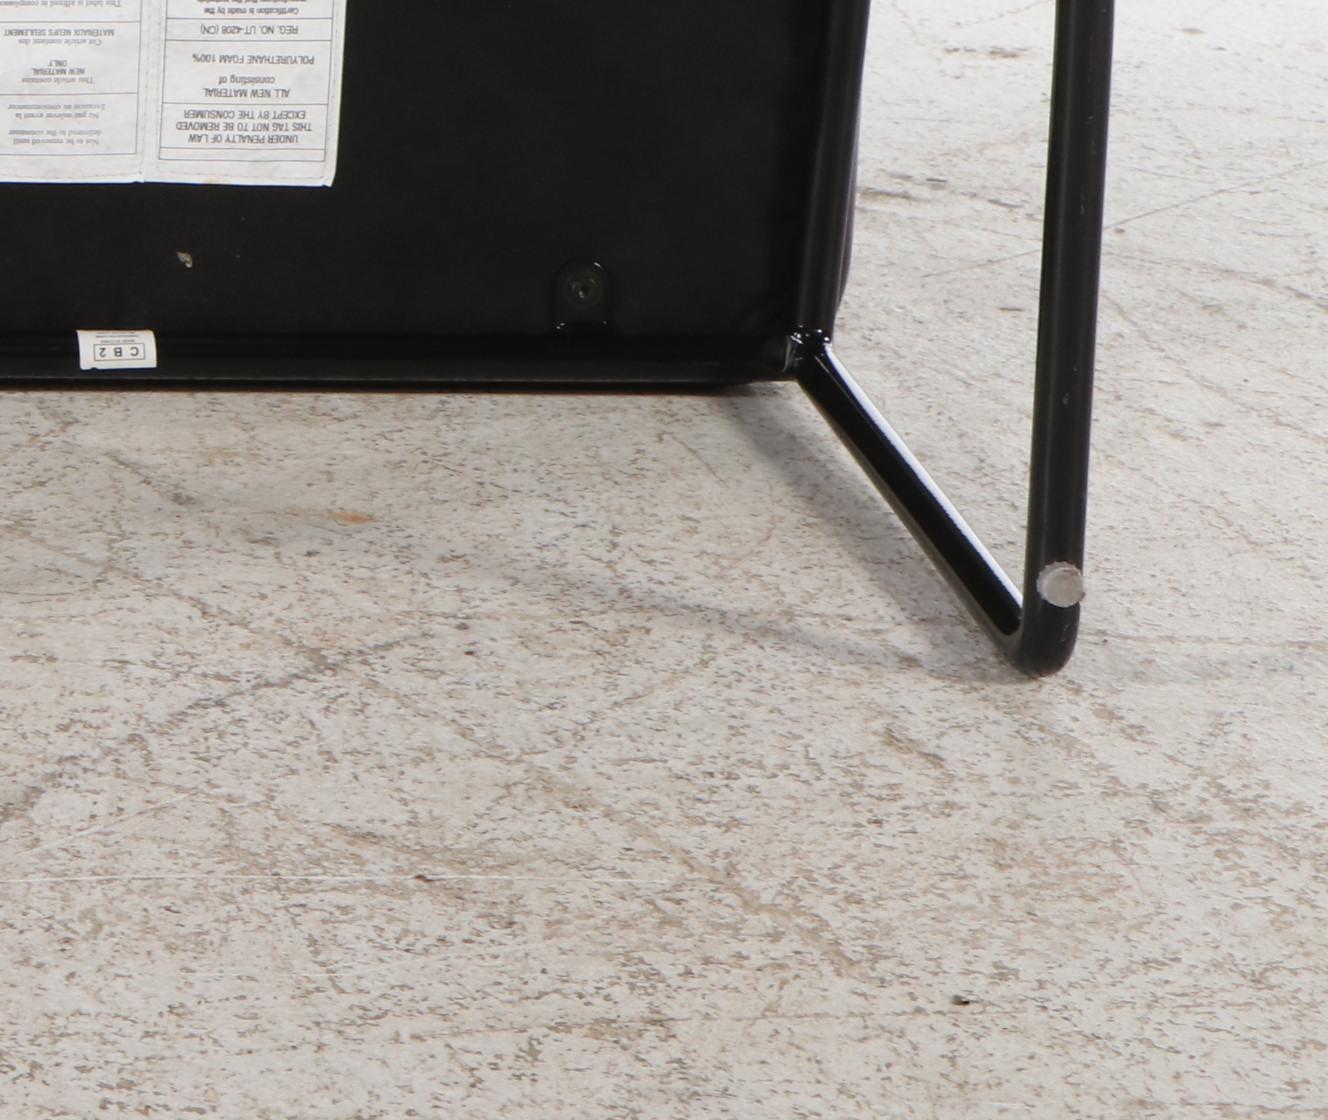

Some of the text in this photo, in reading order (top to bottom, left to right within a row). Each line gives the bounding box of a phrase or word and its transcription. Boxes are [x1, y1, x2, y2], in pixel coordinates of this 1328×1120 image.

[200, 26, 220, 34] (CN)
[192, 54, 314, 64] POLYURETHANE FOAM 100%
[219, 75, 275, 84] consisting of
[203, 88, 290, 97] ALL NEW MATERIAL
[184, 110, 305, 119] EXCEPT BY THE CONSUMER
[176, 122, 312, 131] THIS TAG NOT TO BE REMOVED
[188, 134, 298, 143] UNDER PENALTY OF LAW
